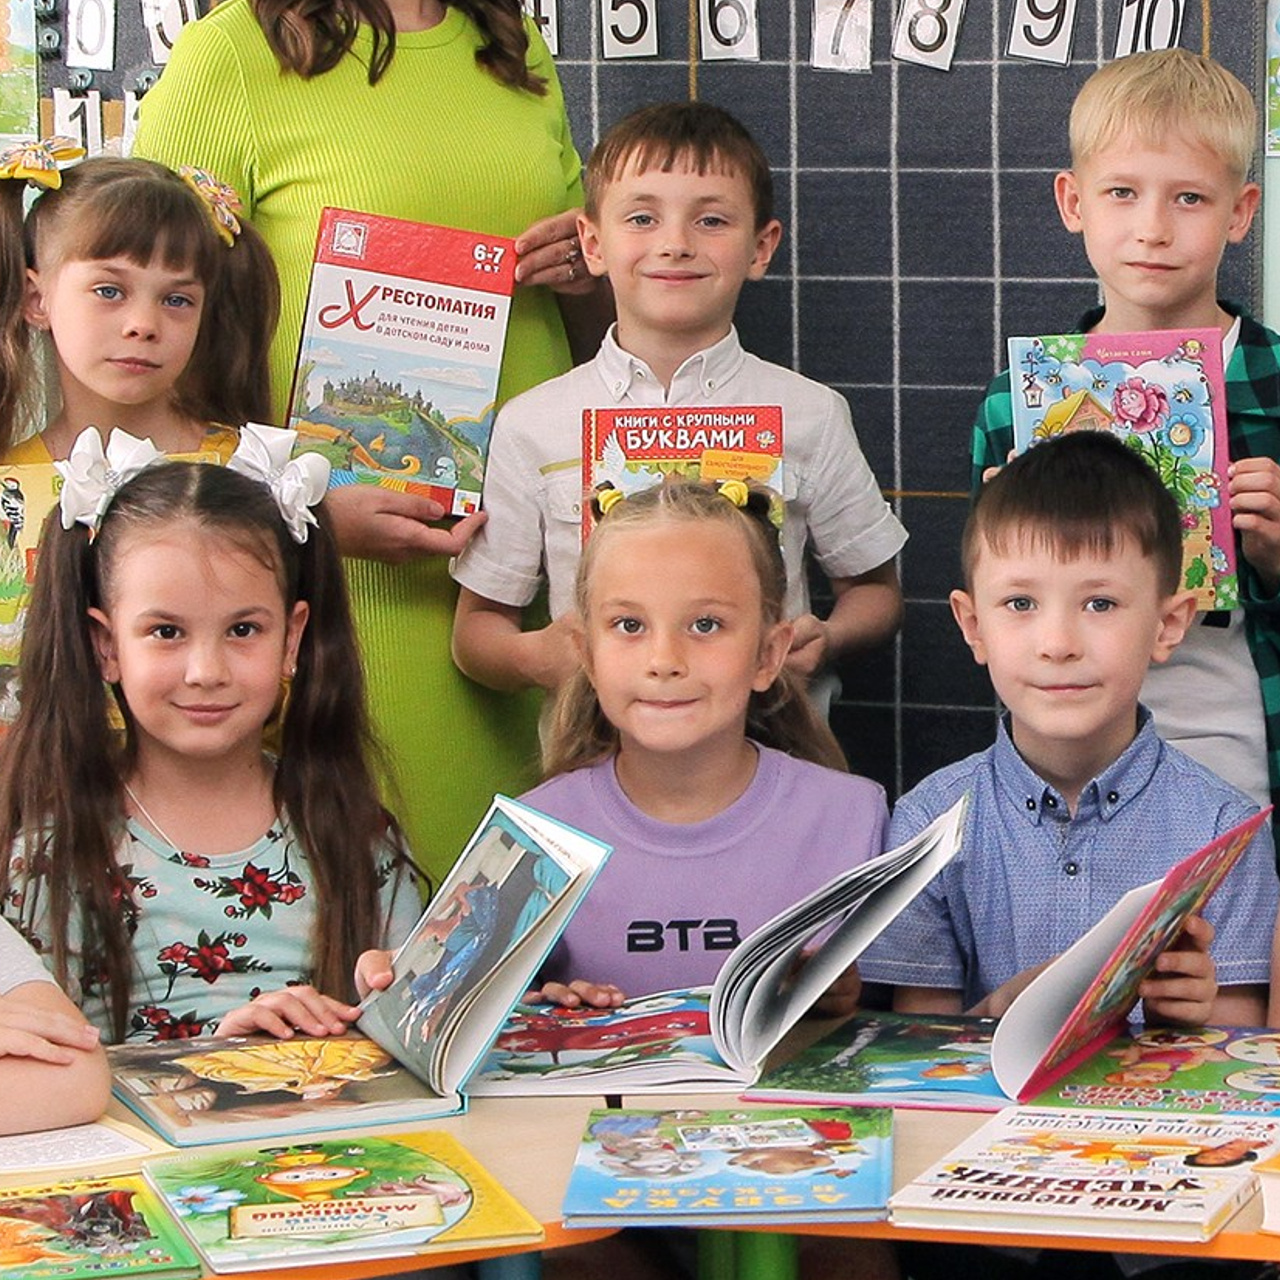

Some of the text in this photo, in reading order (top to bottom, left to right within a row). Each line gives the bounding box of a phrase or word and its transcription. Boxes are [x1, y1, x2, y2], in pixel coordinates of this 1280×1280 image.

[473, 243, 505, 264] 6-7
[400, 315, 436, 330] чтения
[436, 321, 469, 335] детям
[429, 333, 454, 348] саду
[615, 414, 755, 428] КНИГИ С КРУПНЫМИ
[626, 429, 745, 450] БУКВАМИ
[935, 1166, 1206, 1194] УЧЕБНИК
[601, 1193, 849, 1209] АЗБУКА
[930, 1187, 1174, 1213] первый Мой
